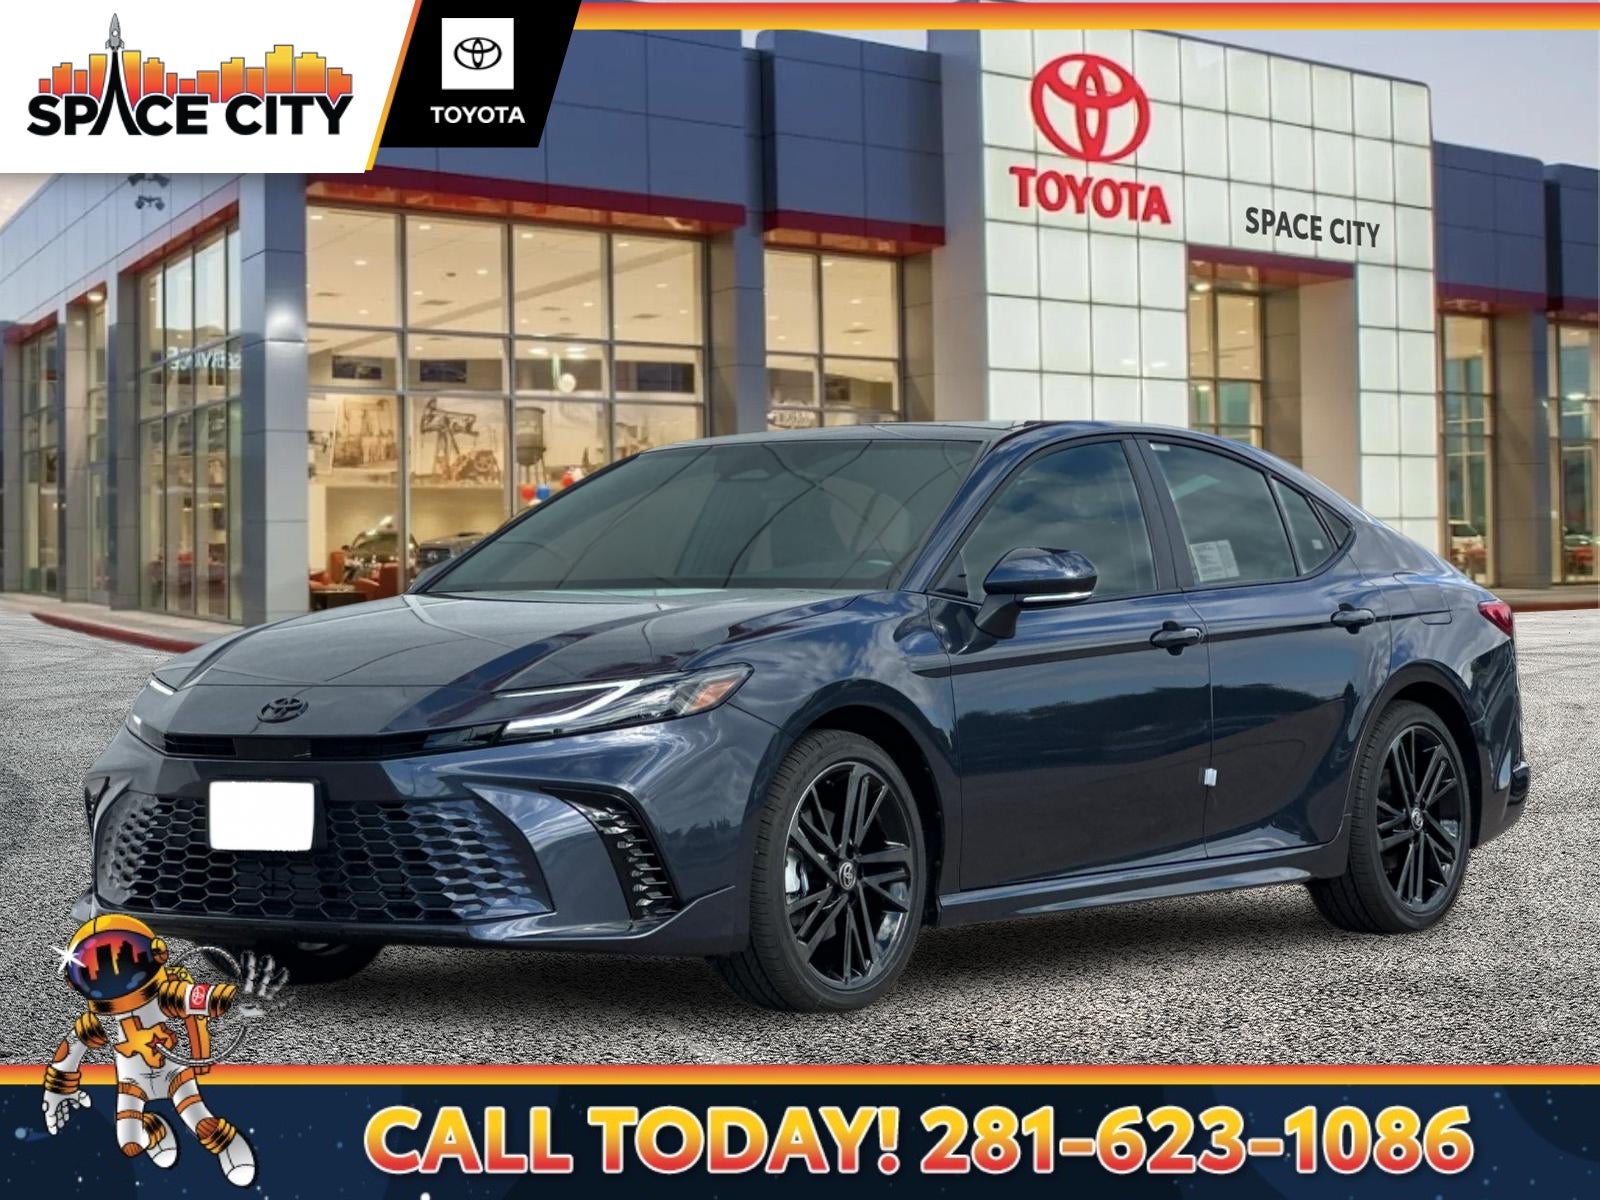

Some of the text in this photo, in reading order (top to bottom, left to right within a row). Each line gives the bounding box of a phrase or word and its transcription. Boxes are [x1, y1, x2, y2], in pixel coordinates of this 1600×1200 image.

[1009, 166, 1171, 224] TOYOTA
[1245, 206, 1381, 248] SPACE CITY
